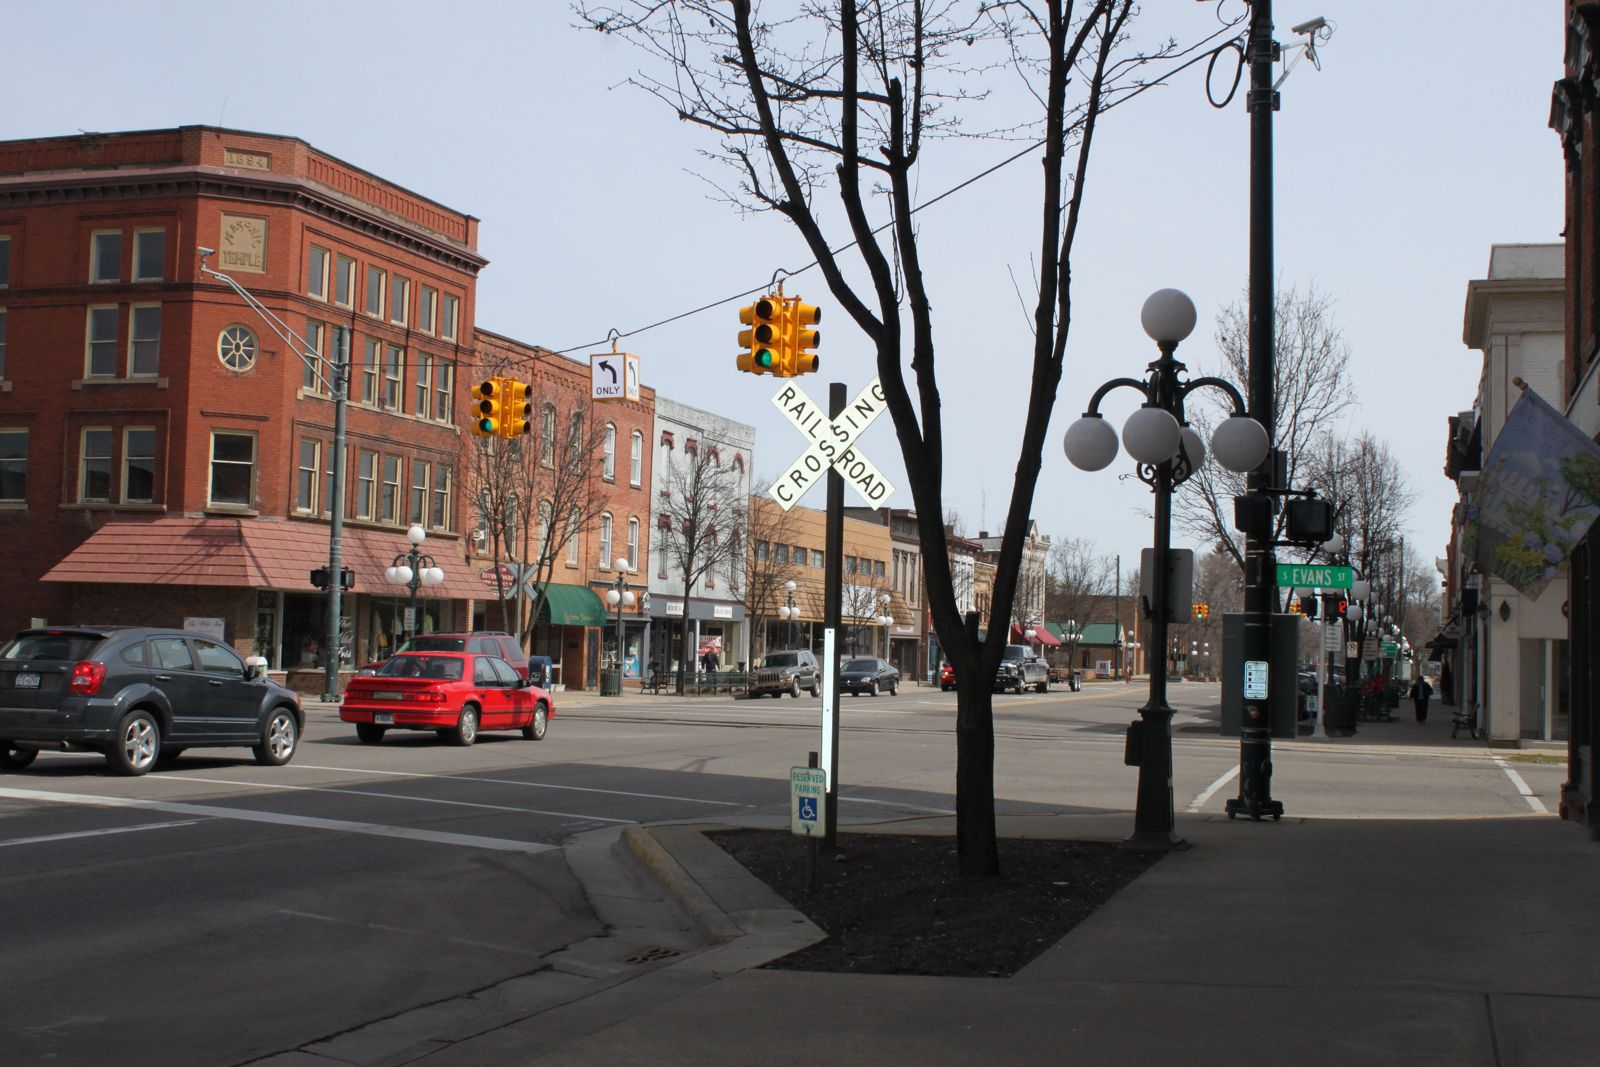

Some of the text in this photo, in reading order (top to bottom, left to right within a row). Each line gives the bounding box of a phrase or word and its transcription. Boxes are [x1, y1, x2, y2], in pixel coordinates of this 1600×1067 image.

[224, 220, 262, 249] MASONIC
[223, 250, 262, 268] TEMPLE
[596, 386, 620, 395] ONLY
[778, 386, 822, 439] RAIL
[776, 384, 887, 502] CROSSING
[837, 448, 886, 500] ROAD
[1282, 568, 1346, 586] S EVANS ST
[792, 772, 824, 783] RESERVED
[795, 784, 821, 795] PARKING
